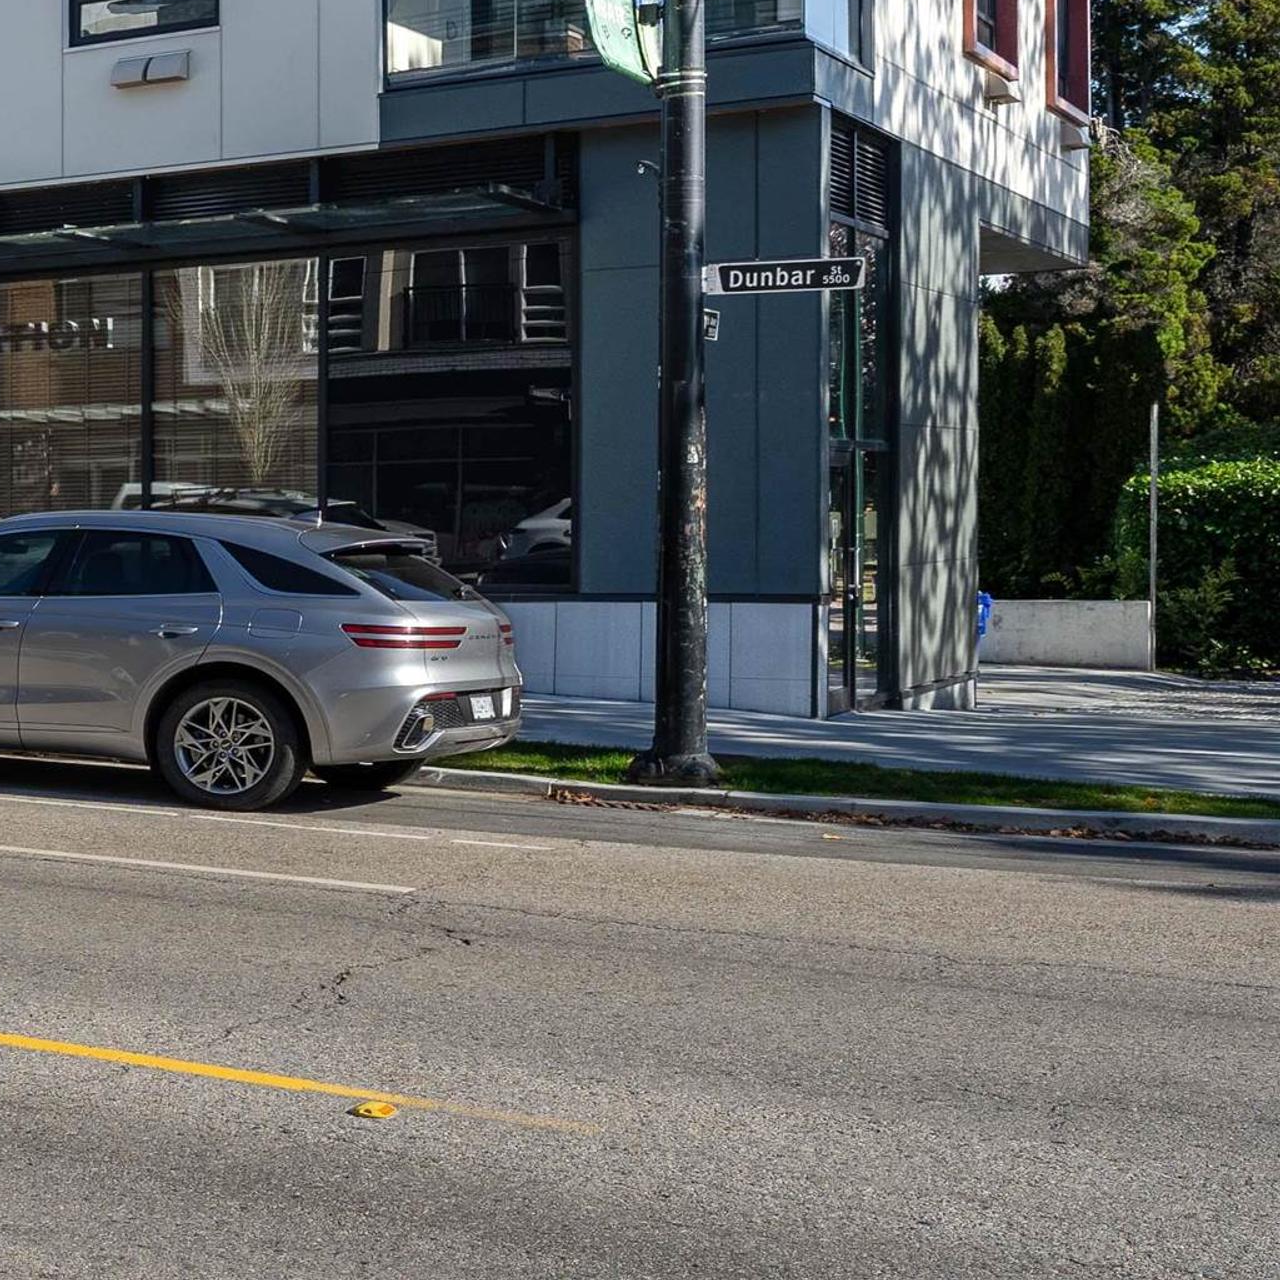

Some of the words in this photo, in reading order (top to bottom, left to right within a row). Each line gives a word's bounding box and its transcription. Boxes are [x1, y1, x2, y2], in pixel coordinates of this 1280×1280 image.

[729, 267, 816, 288] Dunbar
[831, 265, 842, 275] St
[822, 273, 850, 284] 5500
